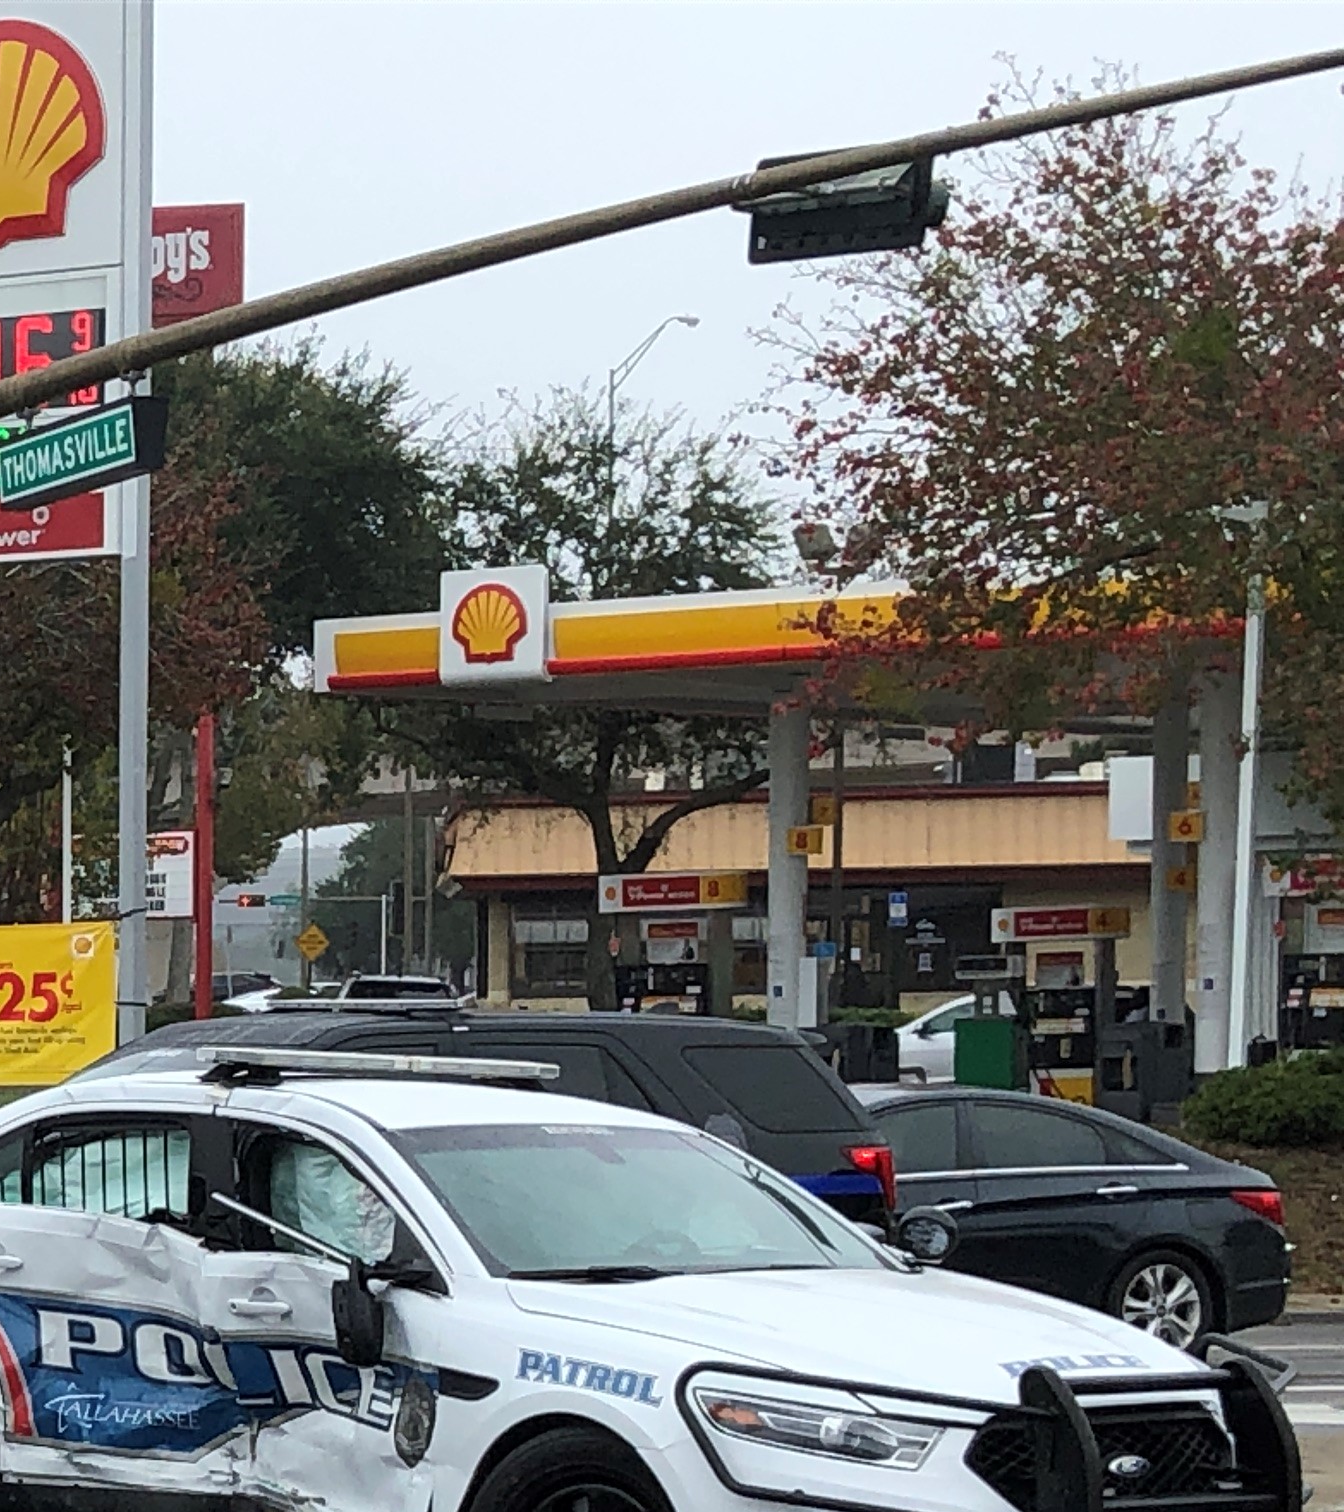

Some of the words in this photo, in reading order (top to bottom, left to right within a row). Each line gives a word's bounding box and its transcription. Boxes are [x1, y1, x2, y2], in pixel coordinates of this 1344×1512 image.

[2, 417, 129, 489] THOMASVILLE
[1178, 816, 1193, 836] 6
[515, 1347, 664, 1409] PATROL
[44, 1384, 202, 1434] TALLAHASSEE
